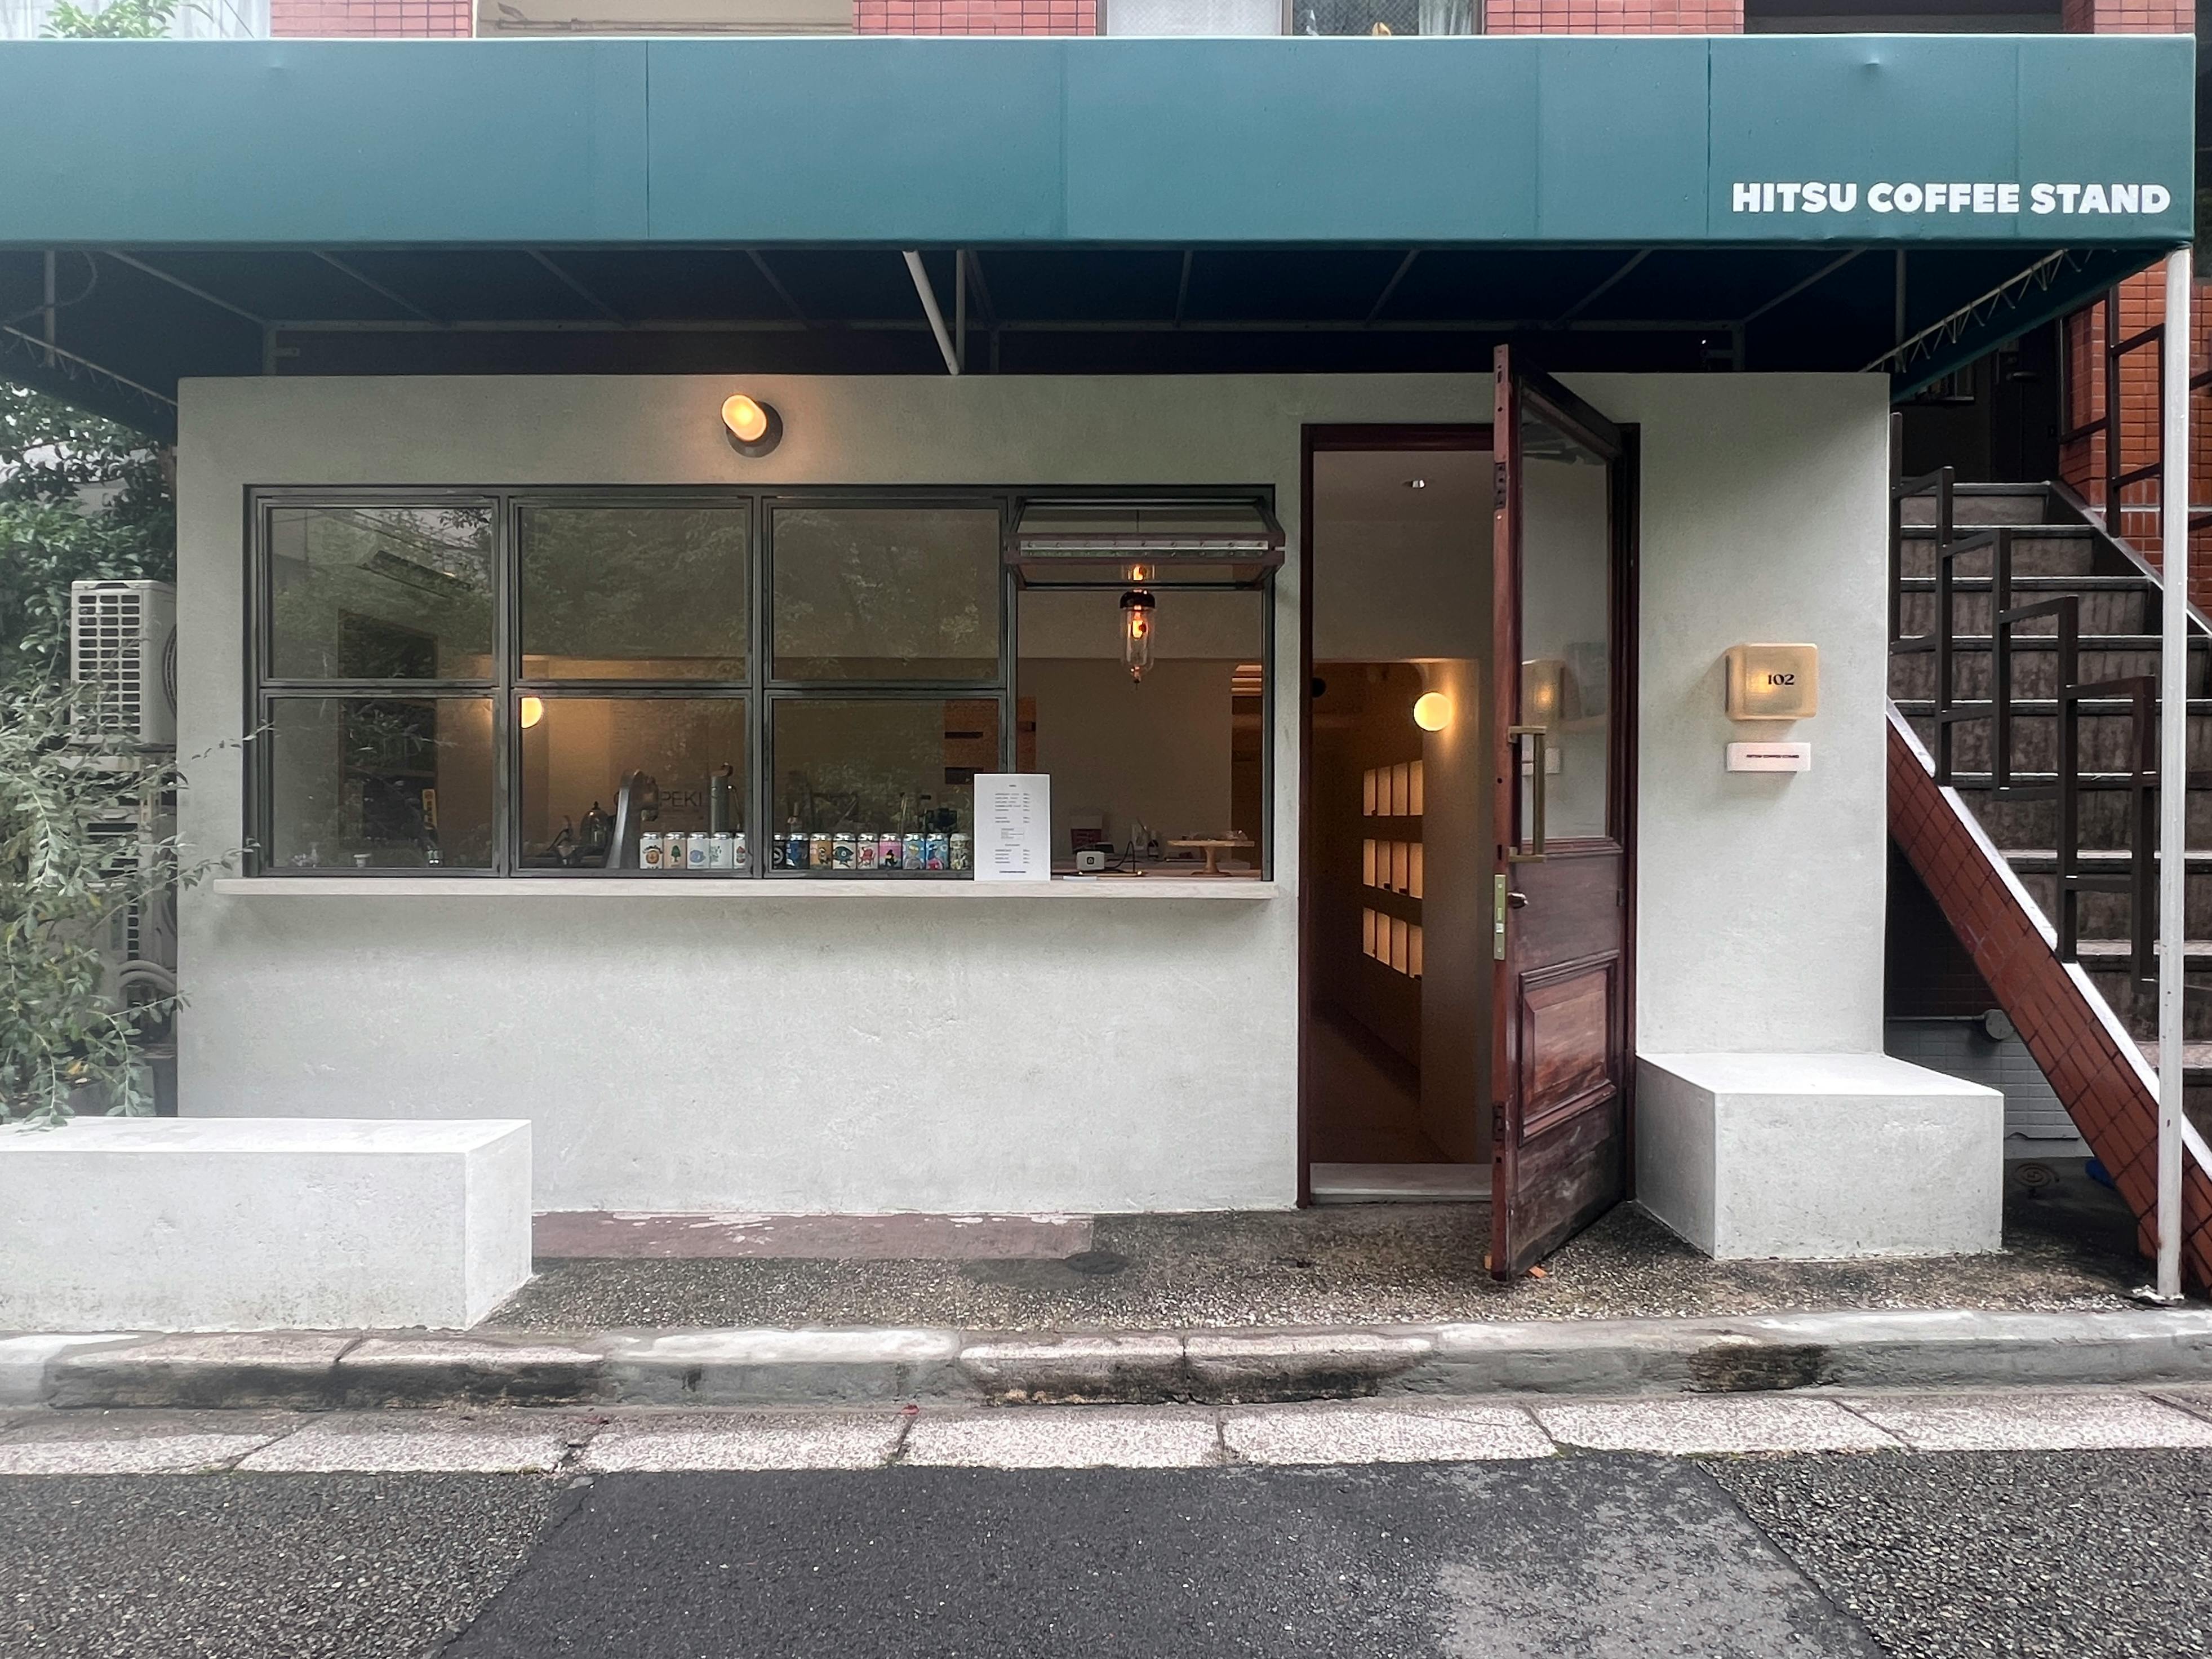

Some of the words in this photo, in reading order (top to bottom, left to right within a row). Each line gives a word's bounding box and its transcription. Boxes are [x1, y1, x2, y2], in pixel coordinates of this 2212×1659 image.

[1733, 182, 1857, 213] HITSU
[1867, 182, 2020, 214] COFFEE
[2030, 183, 2171, 214] STAND
[1767, 673, 1795, 686] 102
